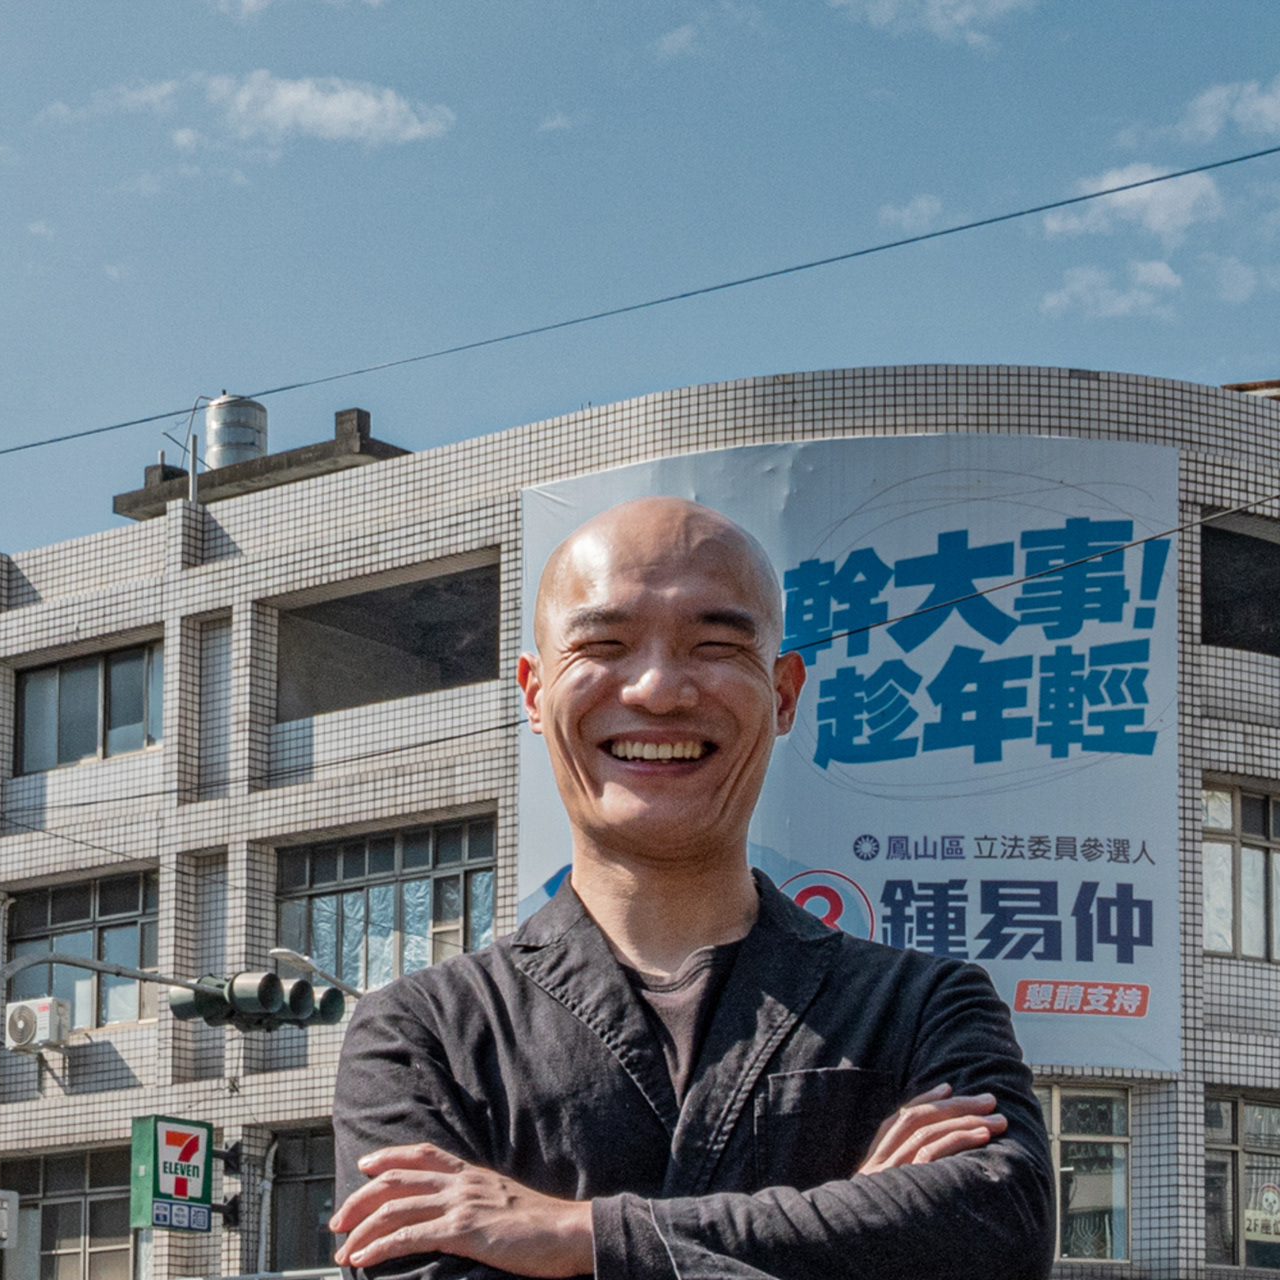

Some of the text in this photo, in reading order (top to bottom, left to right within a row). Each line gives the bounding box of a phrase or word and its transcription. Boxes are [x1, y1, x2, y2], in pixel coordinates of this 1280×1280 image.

[813, 637, 1158, 770] 趁年輕
[885, 834, 1156, 865] 鳳山區 立法委員參選人
[880, 879, 1154, 964] 鍾易仲
[1023, 983, 1143, 1014] 懇請支持
